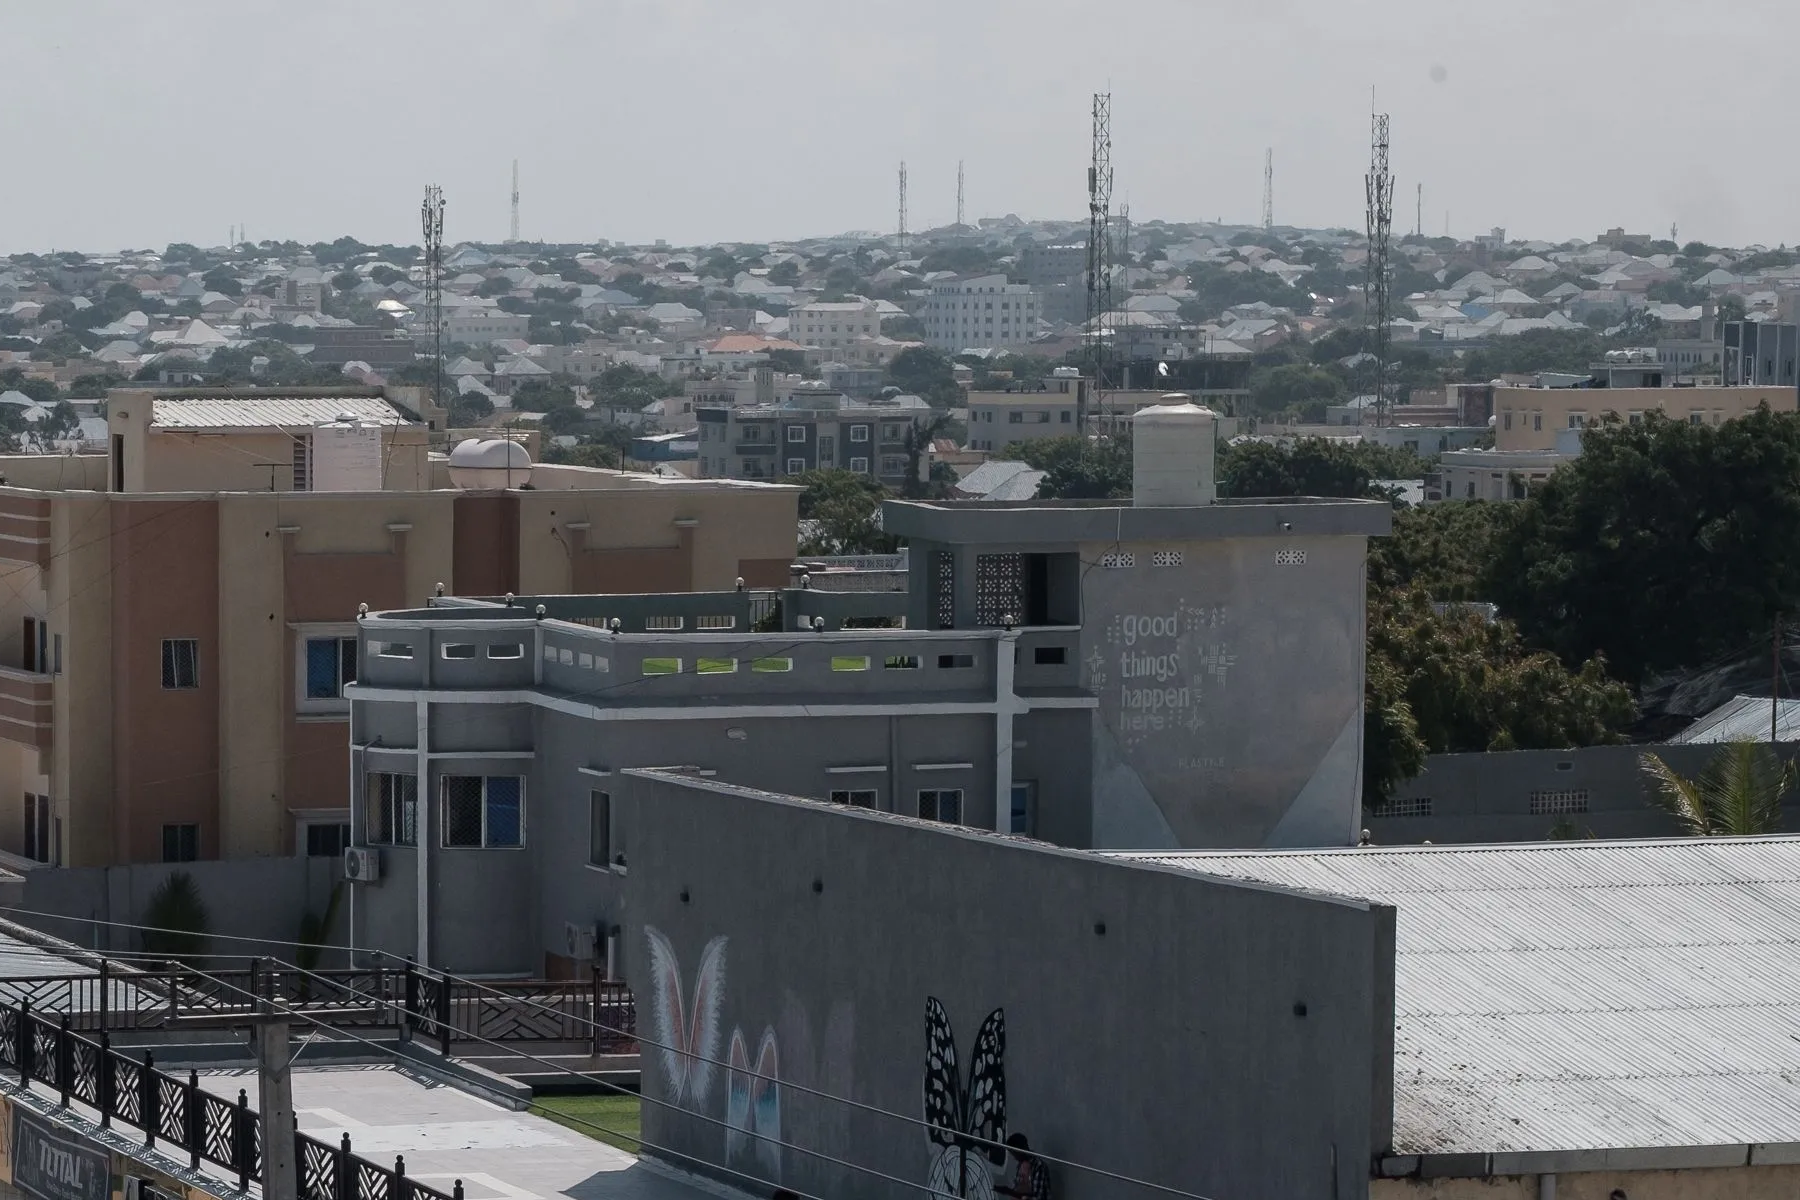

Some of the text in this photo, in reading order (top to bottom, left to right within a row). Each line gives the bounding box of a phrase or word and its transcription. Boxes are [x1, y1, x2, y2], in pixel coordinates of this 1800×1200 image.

[1122, 612, 1178, 646] good
[1121, 650, 1180, 682] things
[1121, 684, 1190, 714] happen
[1120, 711, 1165, 731] here
[38, 1138, 84, 1190] TOTAL
